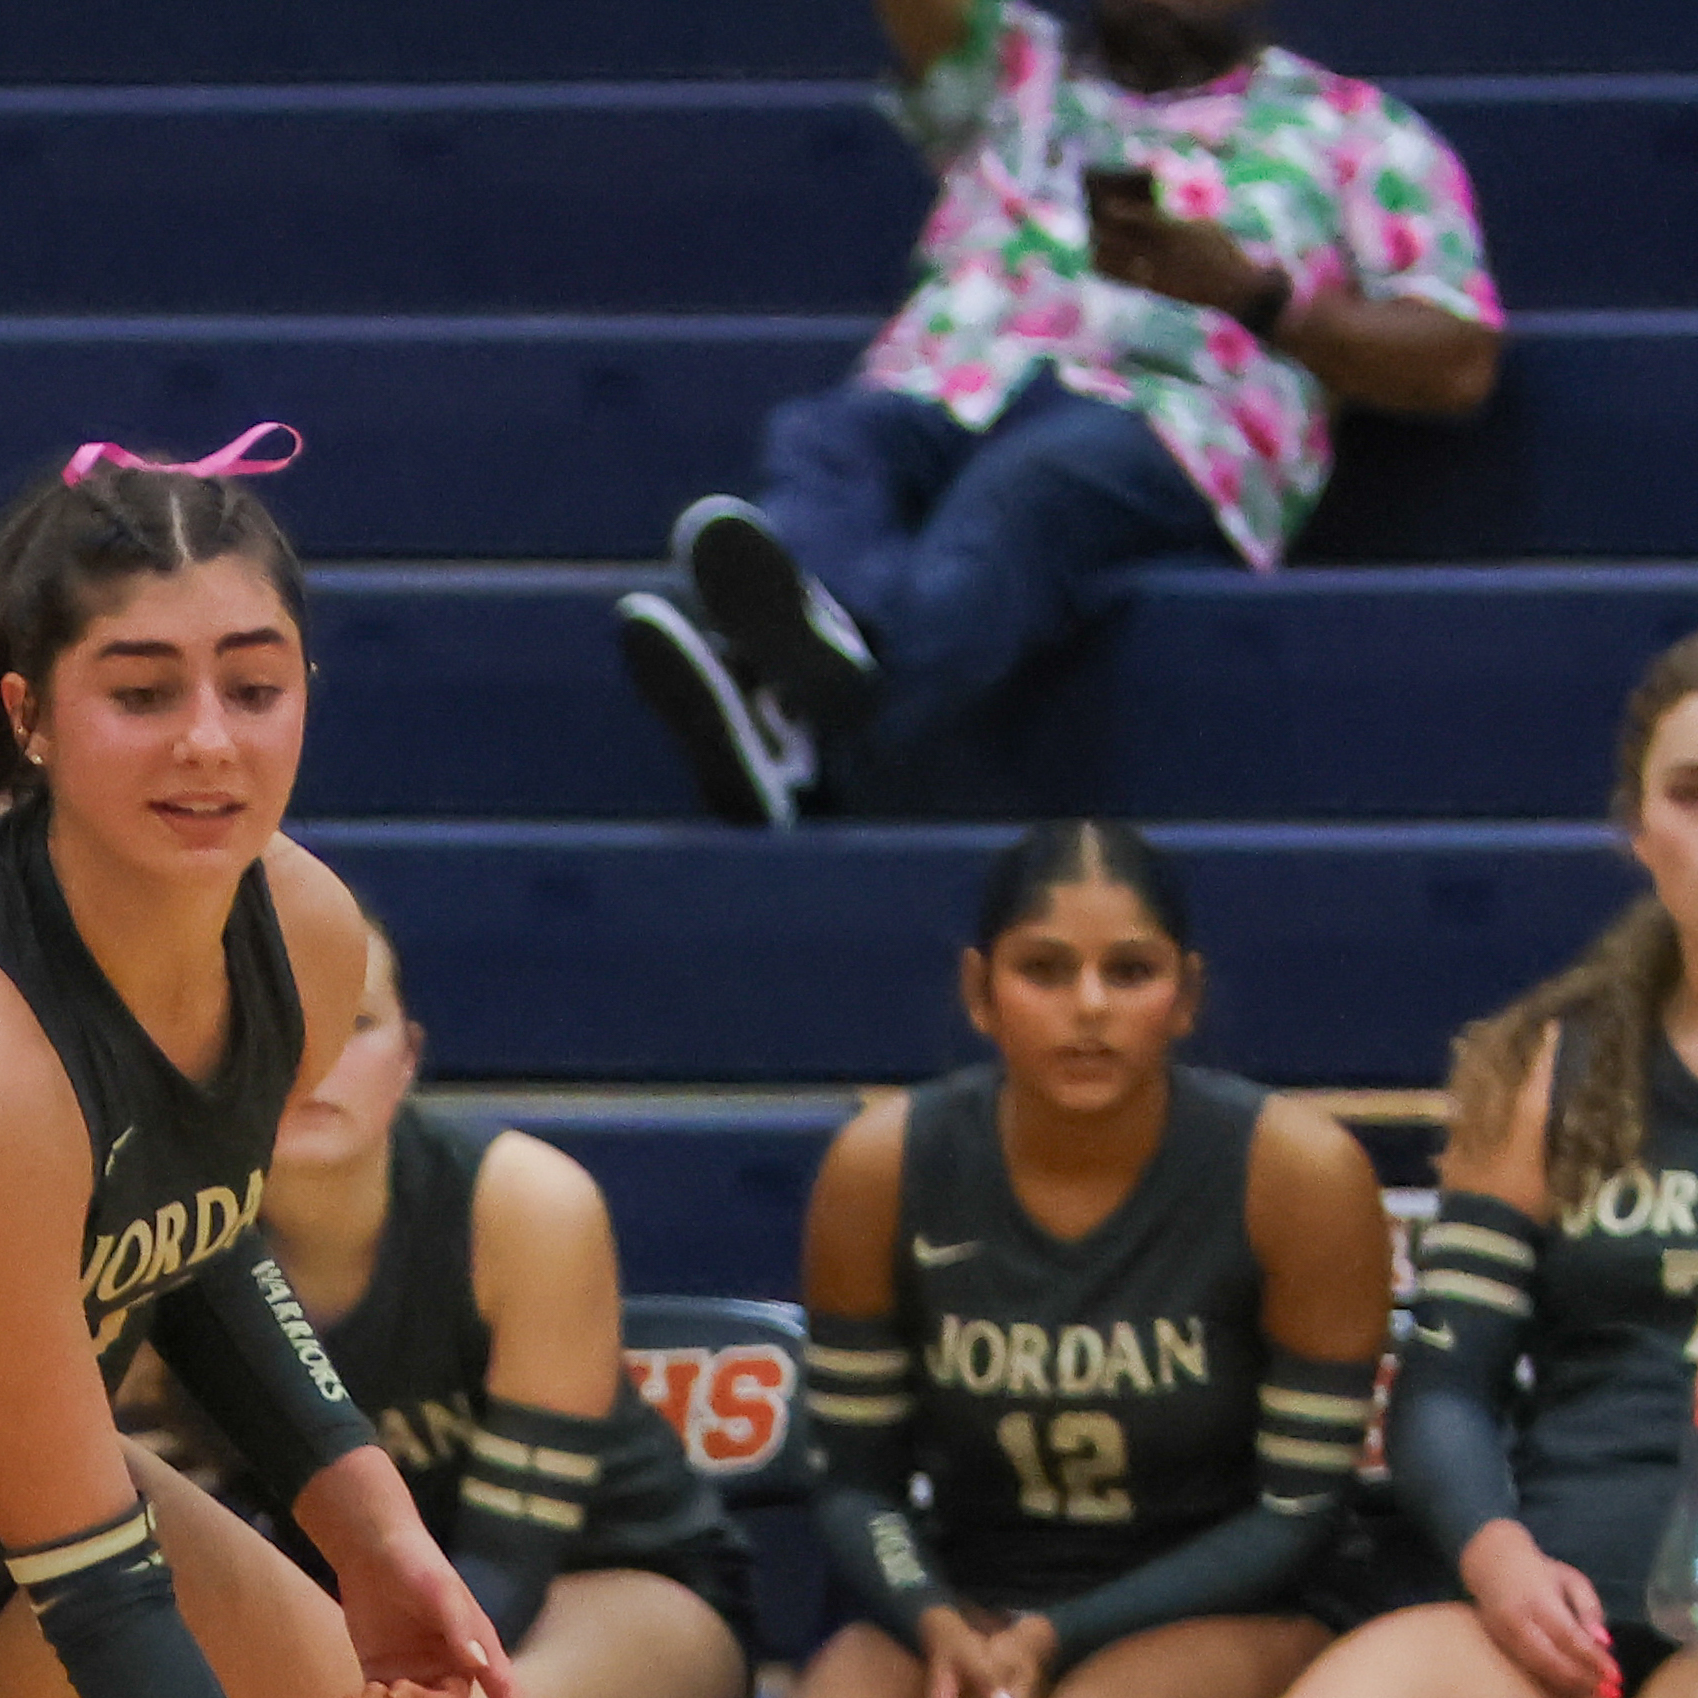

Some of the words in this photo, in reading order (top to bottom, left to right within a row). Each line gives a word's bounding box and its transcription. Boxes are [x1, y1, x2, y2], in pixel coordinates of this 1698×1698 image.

[250, 1257, 352, 1402] WARRIORS
[923, 1313, 1207, 1396] JORDAN
[995, 1410, 1134, 1523] 12
